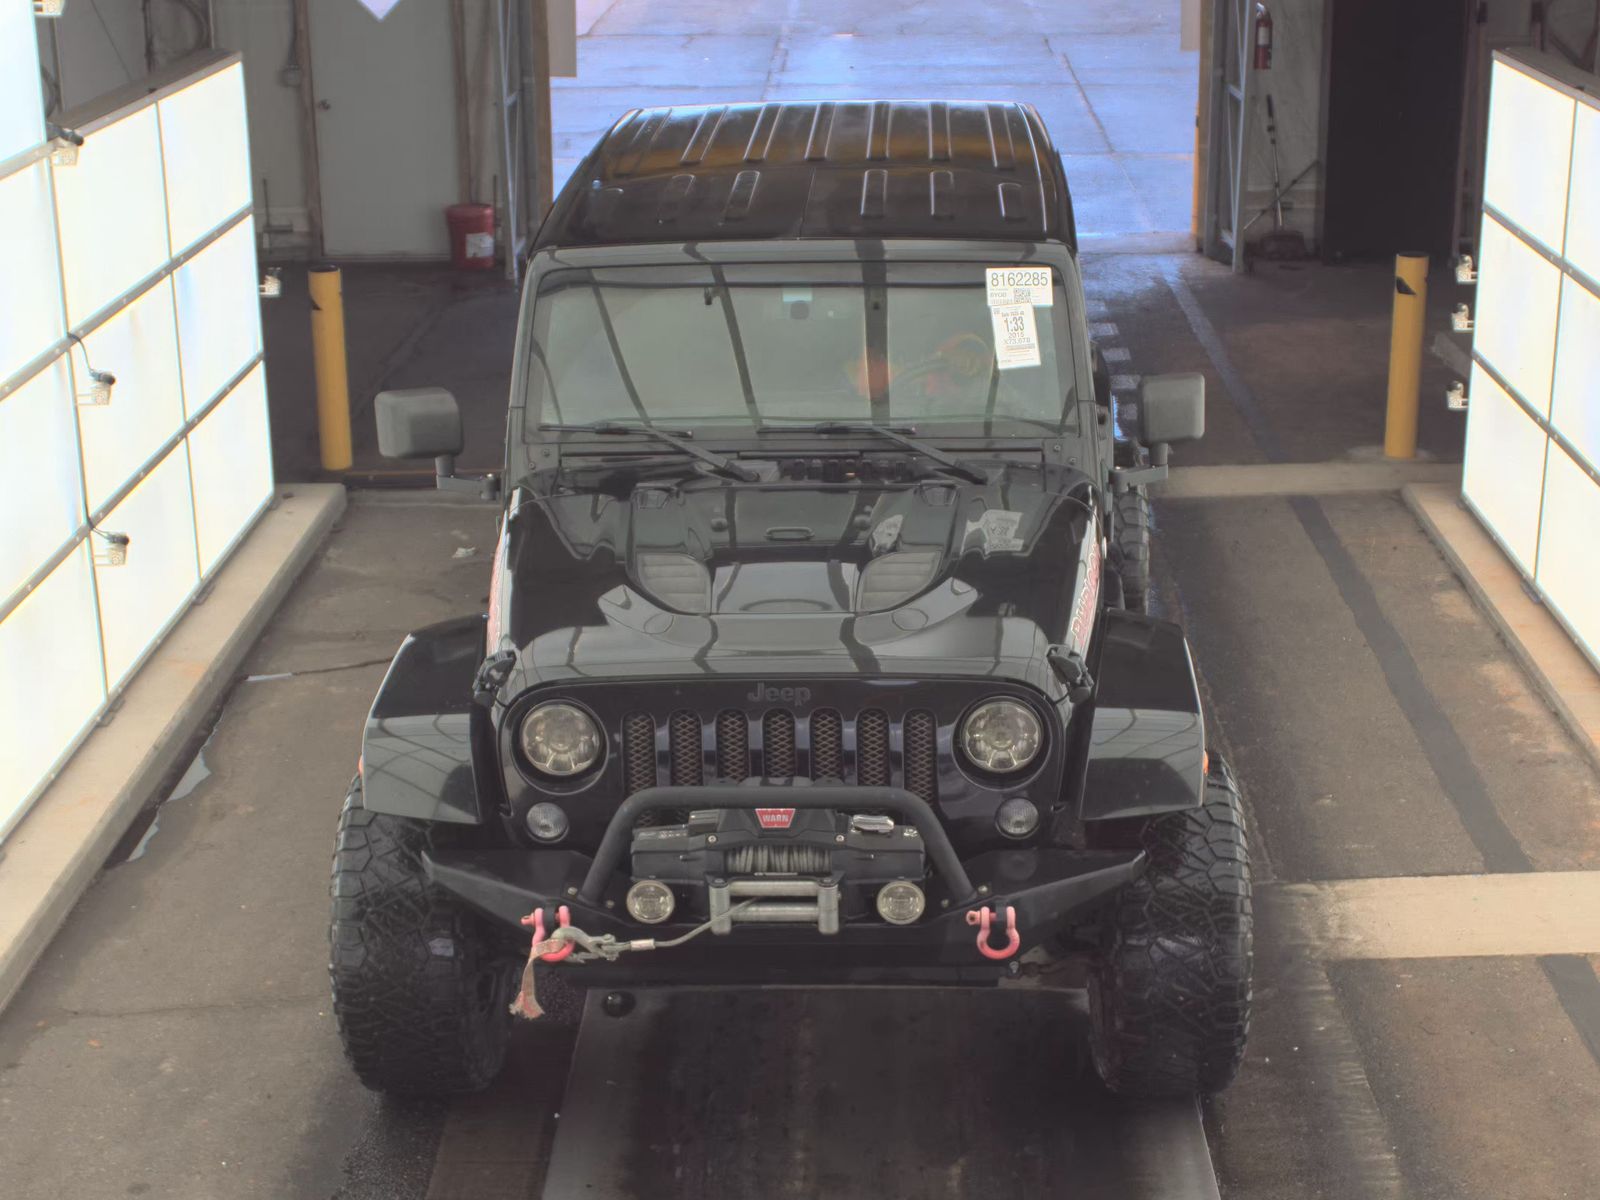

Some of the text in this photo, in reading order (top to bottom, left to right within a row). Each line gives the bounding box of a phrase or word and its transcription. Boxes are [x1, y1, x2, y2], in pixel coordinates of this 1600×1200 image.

[991, 272, 1048, 286] 8162285
[1004, 316, 1025, 332] 1:33
[747, 682, 811, 706] Jeep
[762, 814, 789, 823] WARN
